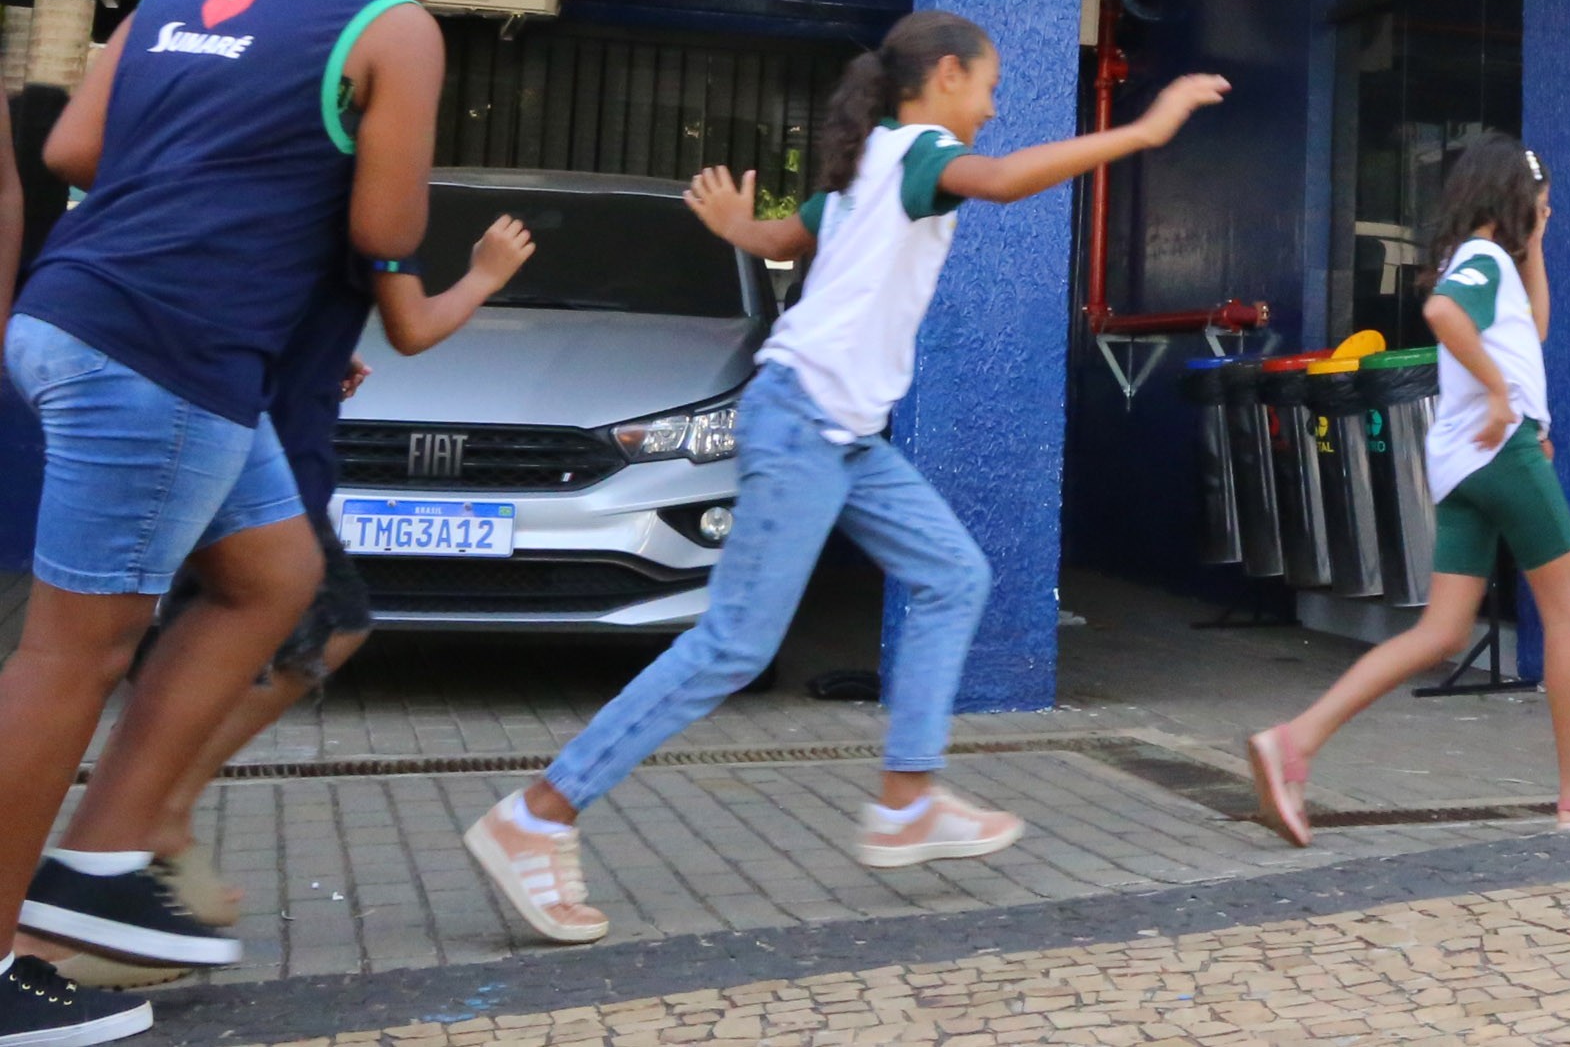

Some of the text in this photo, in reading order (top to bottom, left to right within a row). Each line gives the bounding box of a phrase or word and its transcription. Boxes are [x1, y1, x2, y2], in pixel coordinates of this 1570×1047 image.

[407, 433, 469, 476] FIAT
[414, 505, 443, 515] BRASIL
[356, 516, 495, 549] TMG3A12
